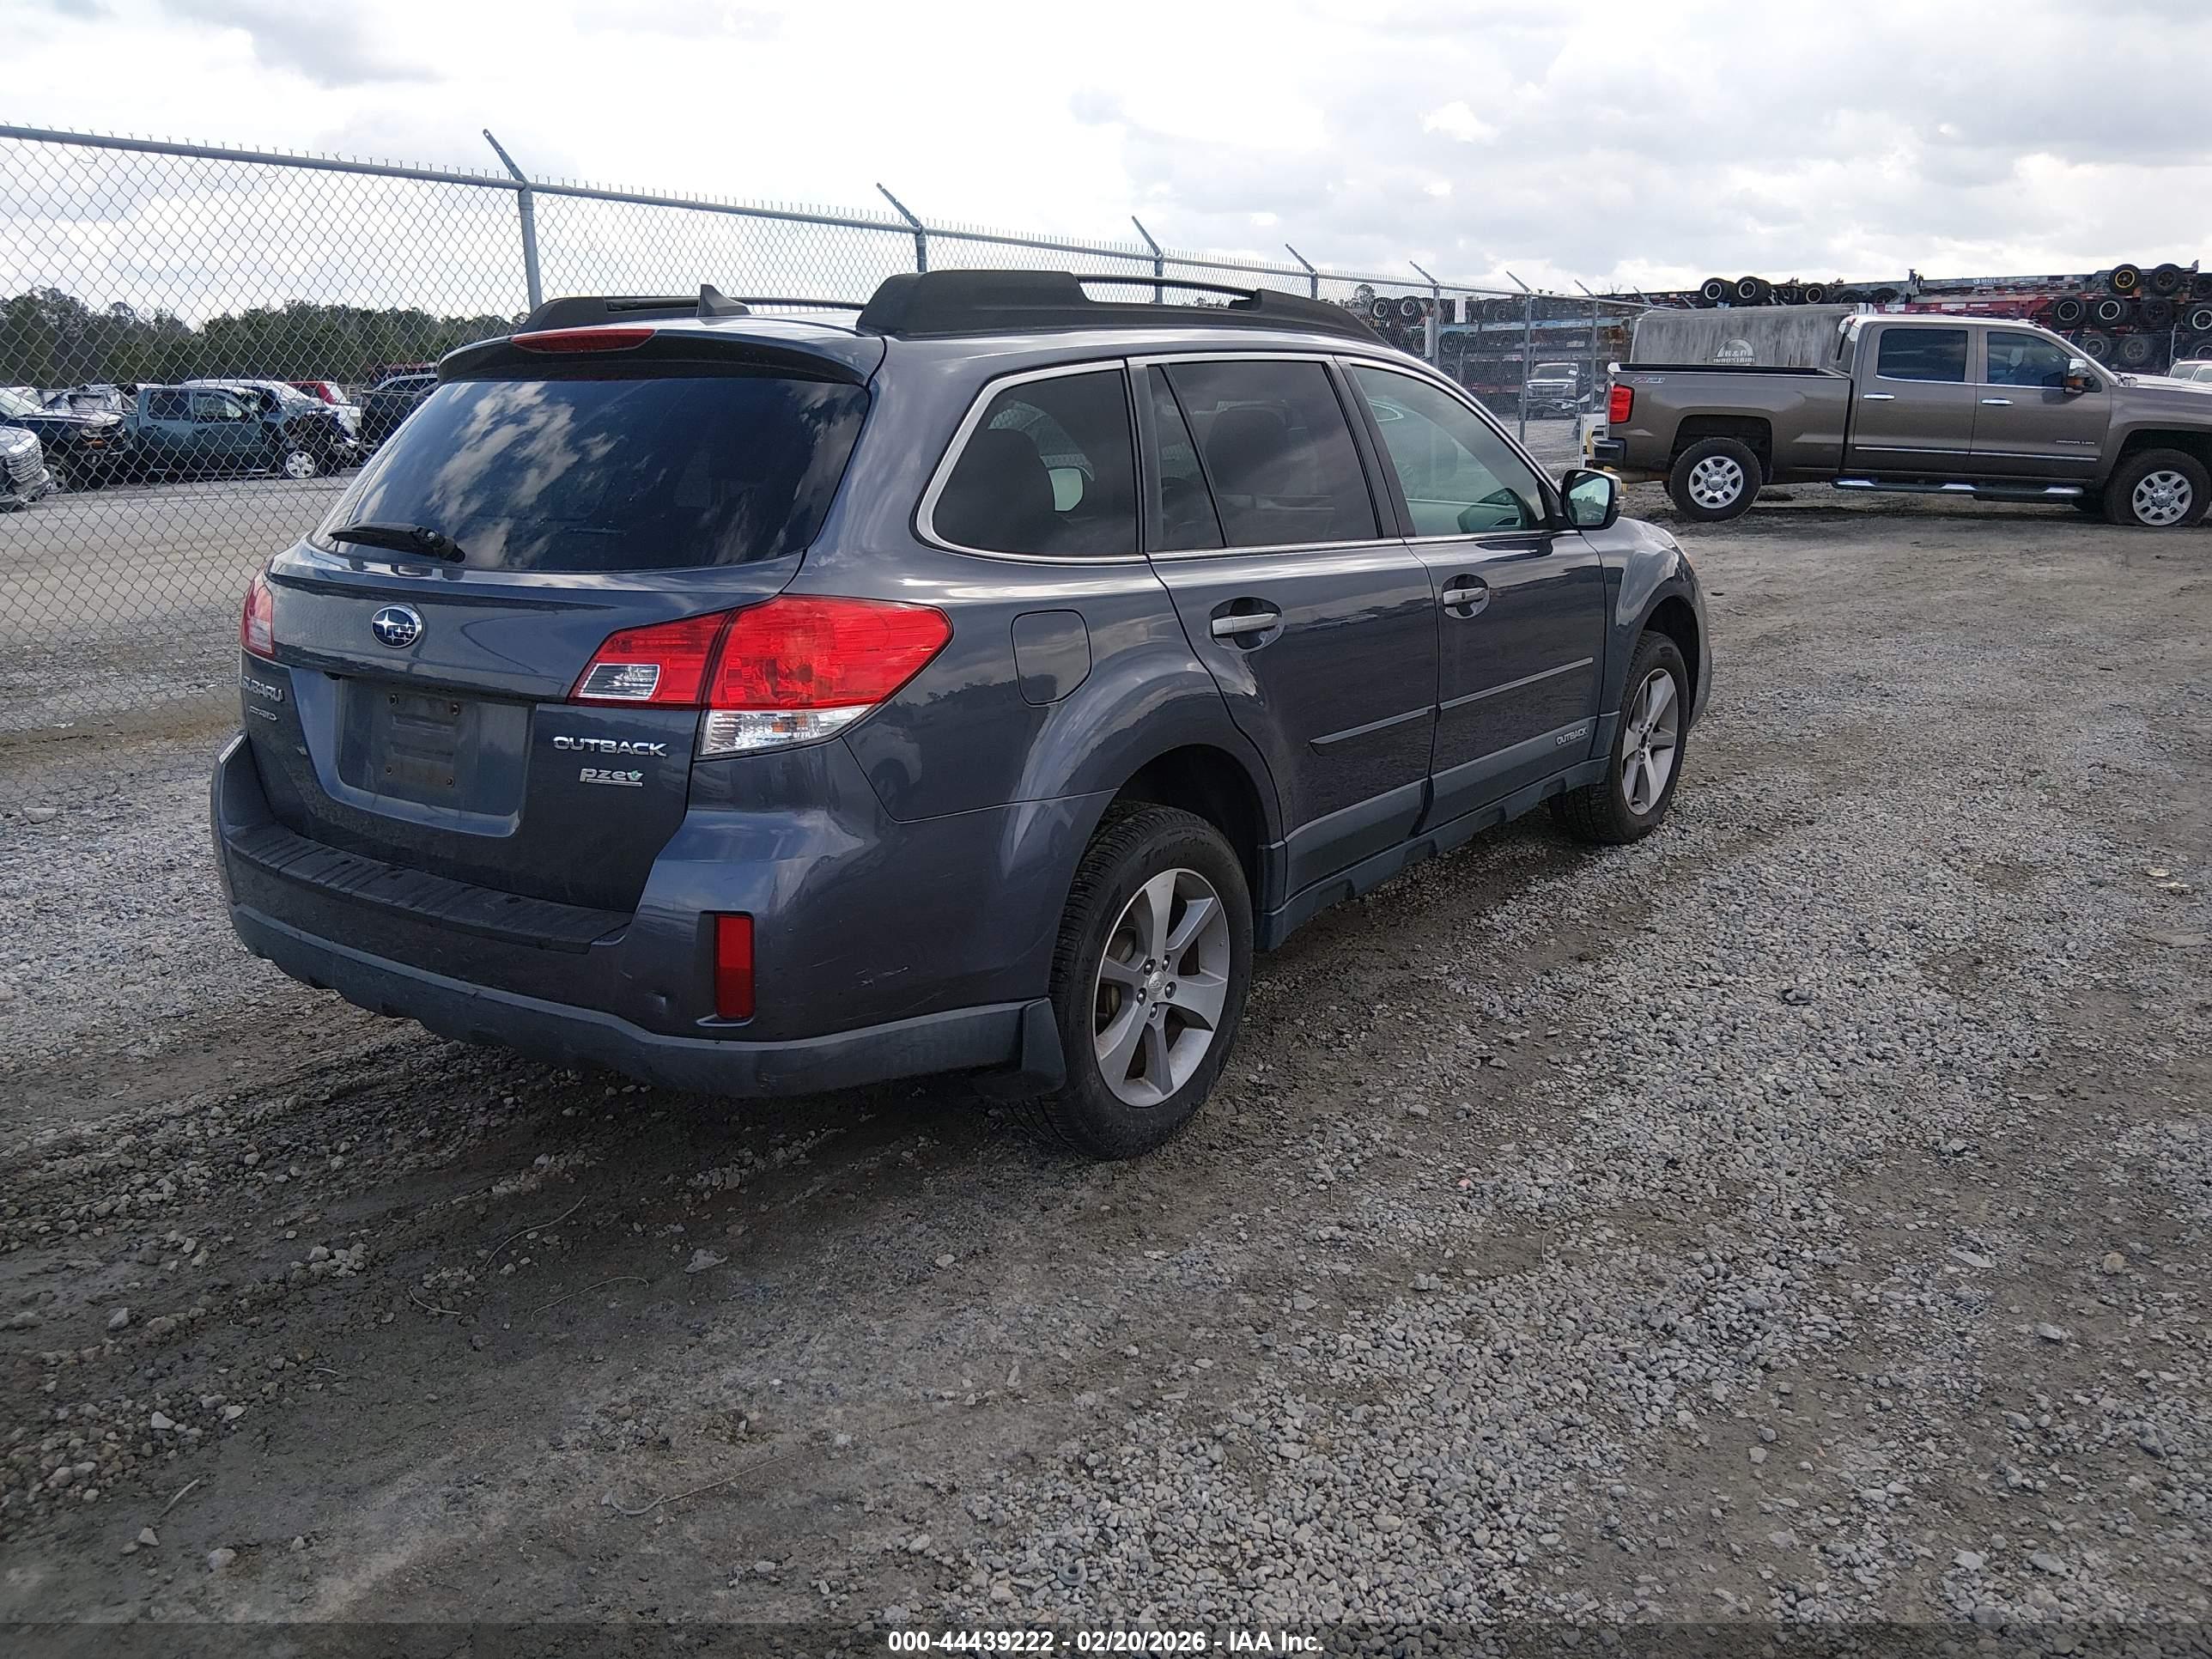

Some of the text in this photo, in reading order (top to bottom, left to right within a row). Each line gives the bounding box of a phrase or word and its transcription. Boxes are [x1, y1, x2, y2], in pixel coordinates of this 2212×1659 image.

[242, 676, 283, 702] SUBARU
[1556, 726, 1588, 745] OUTBACK
[553, 736, 667, 757] OUTBACK
